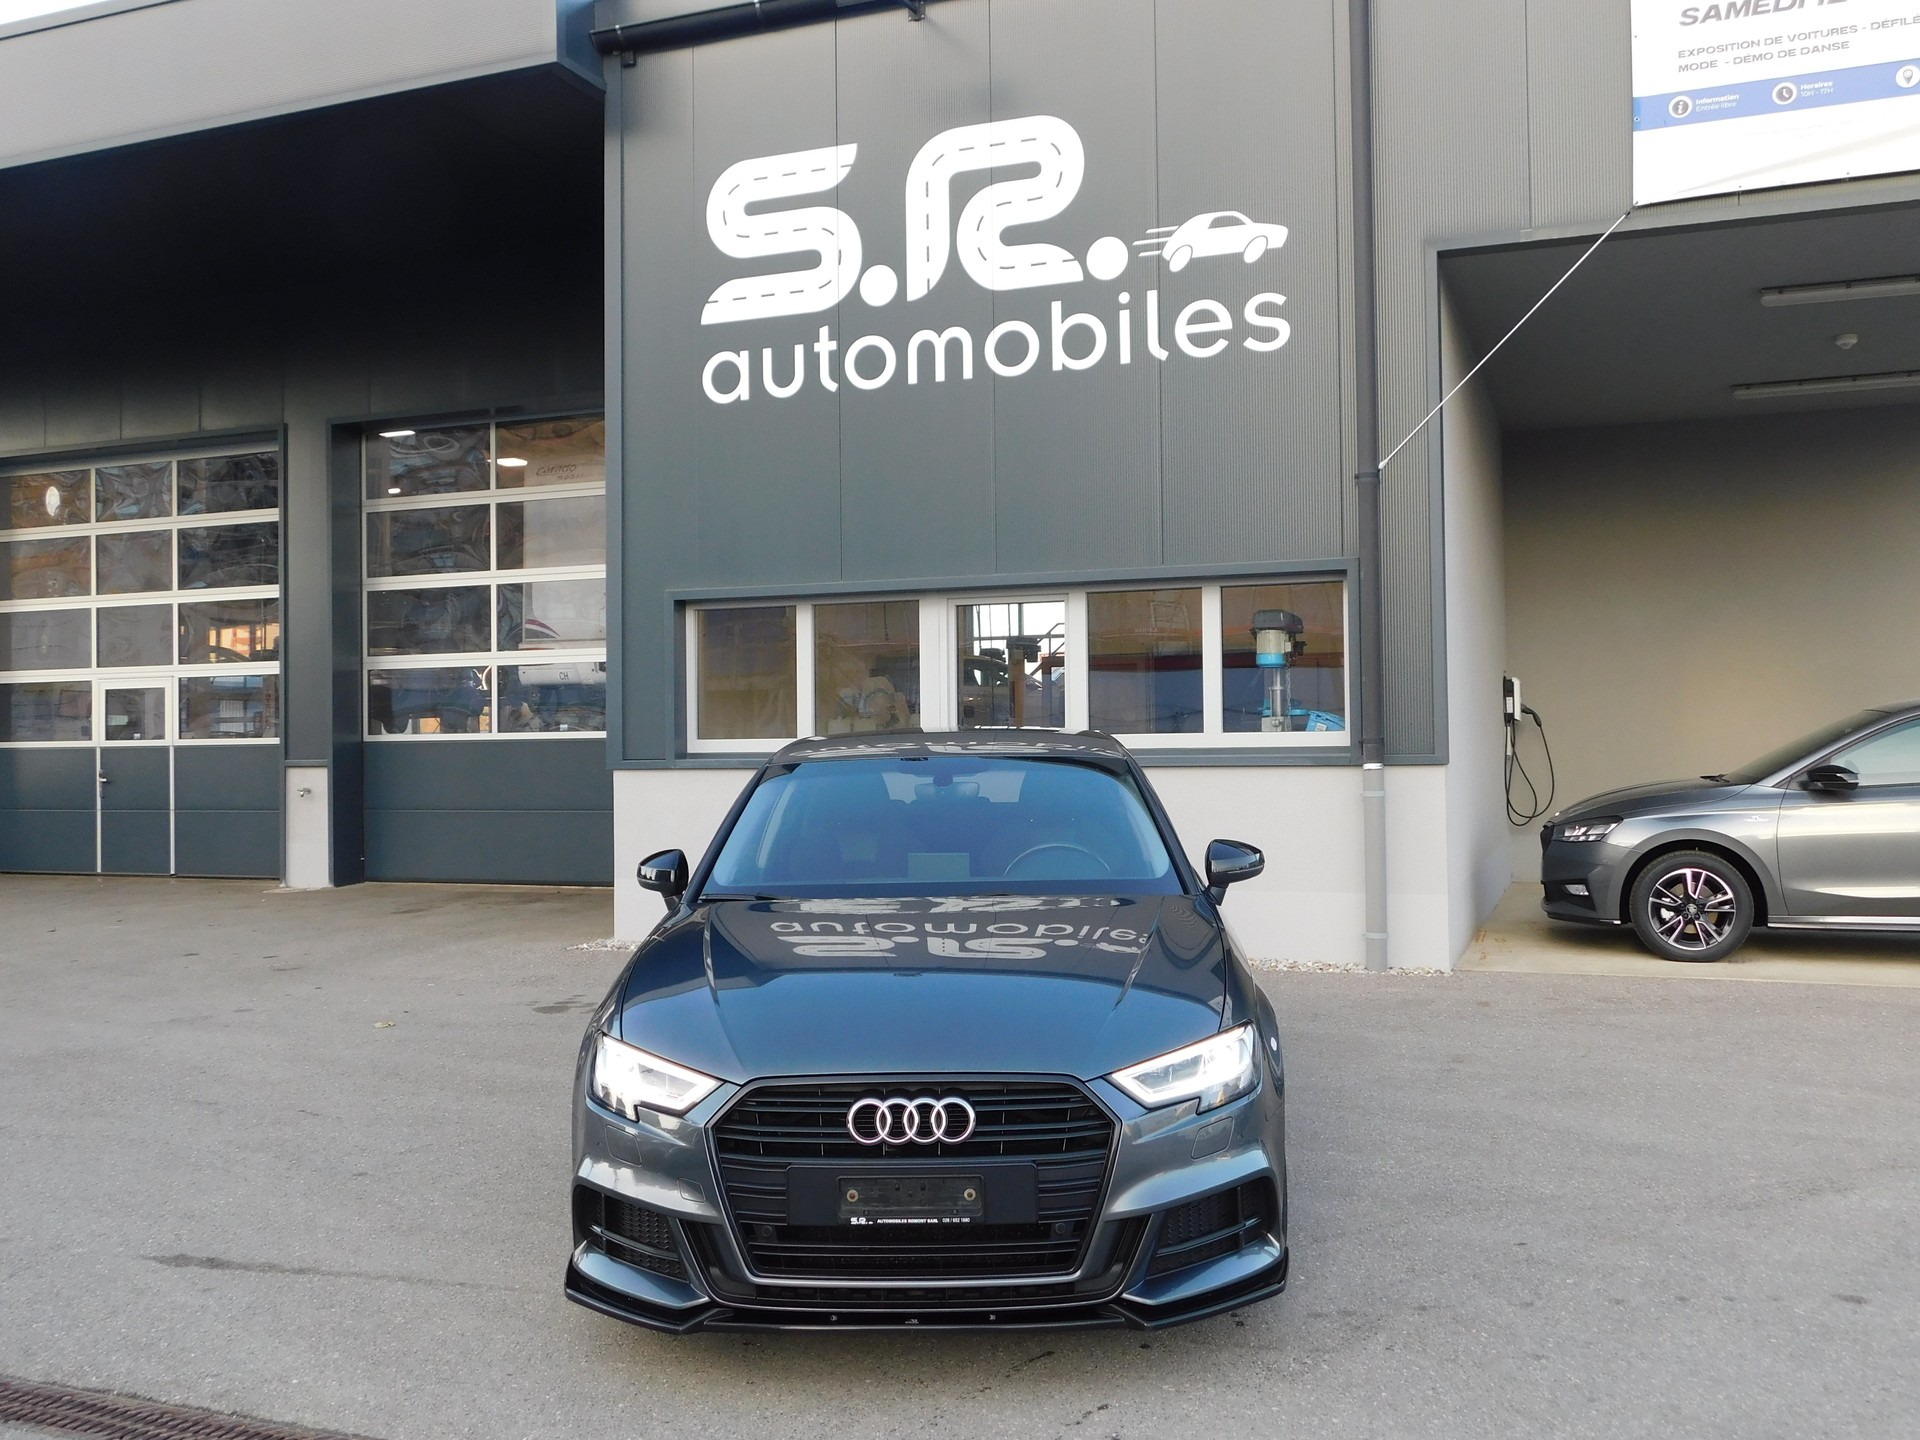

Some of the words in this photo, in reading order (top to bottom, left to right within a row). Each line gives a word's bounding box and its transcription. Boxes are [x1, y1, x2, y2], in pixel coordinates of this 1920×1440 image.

[1678, 39, 1760, 58] EXPOSITION
[1764, 36, 1783, 46] DE
[1787, 25, 1858, 42] VOITURES
[1678, 60, 1718, 73] MODE
[1733, 53, 1774, 65] DÉMO
[1777, 48, 1796, 59] DE
[1800, 41, 1850, 56] DANSE
[1695, 94, 1740, 106] Information
[701, 289, 1292, 405] automobiles
[558, 671, 569, 681] CH
